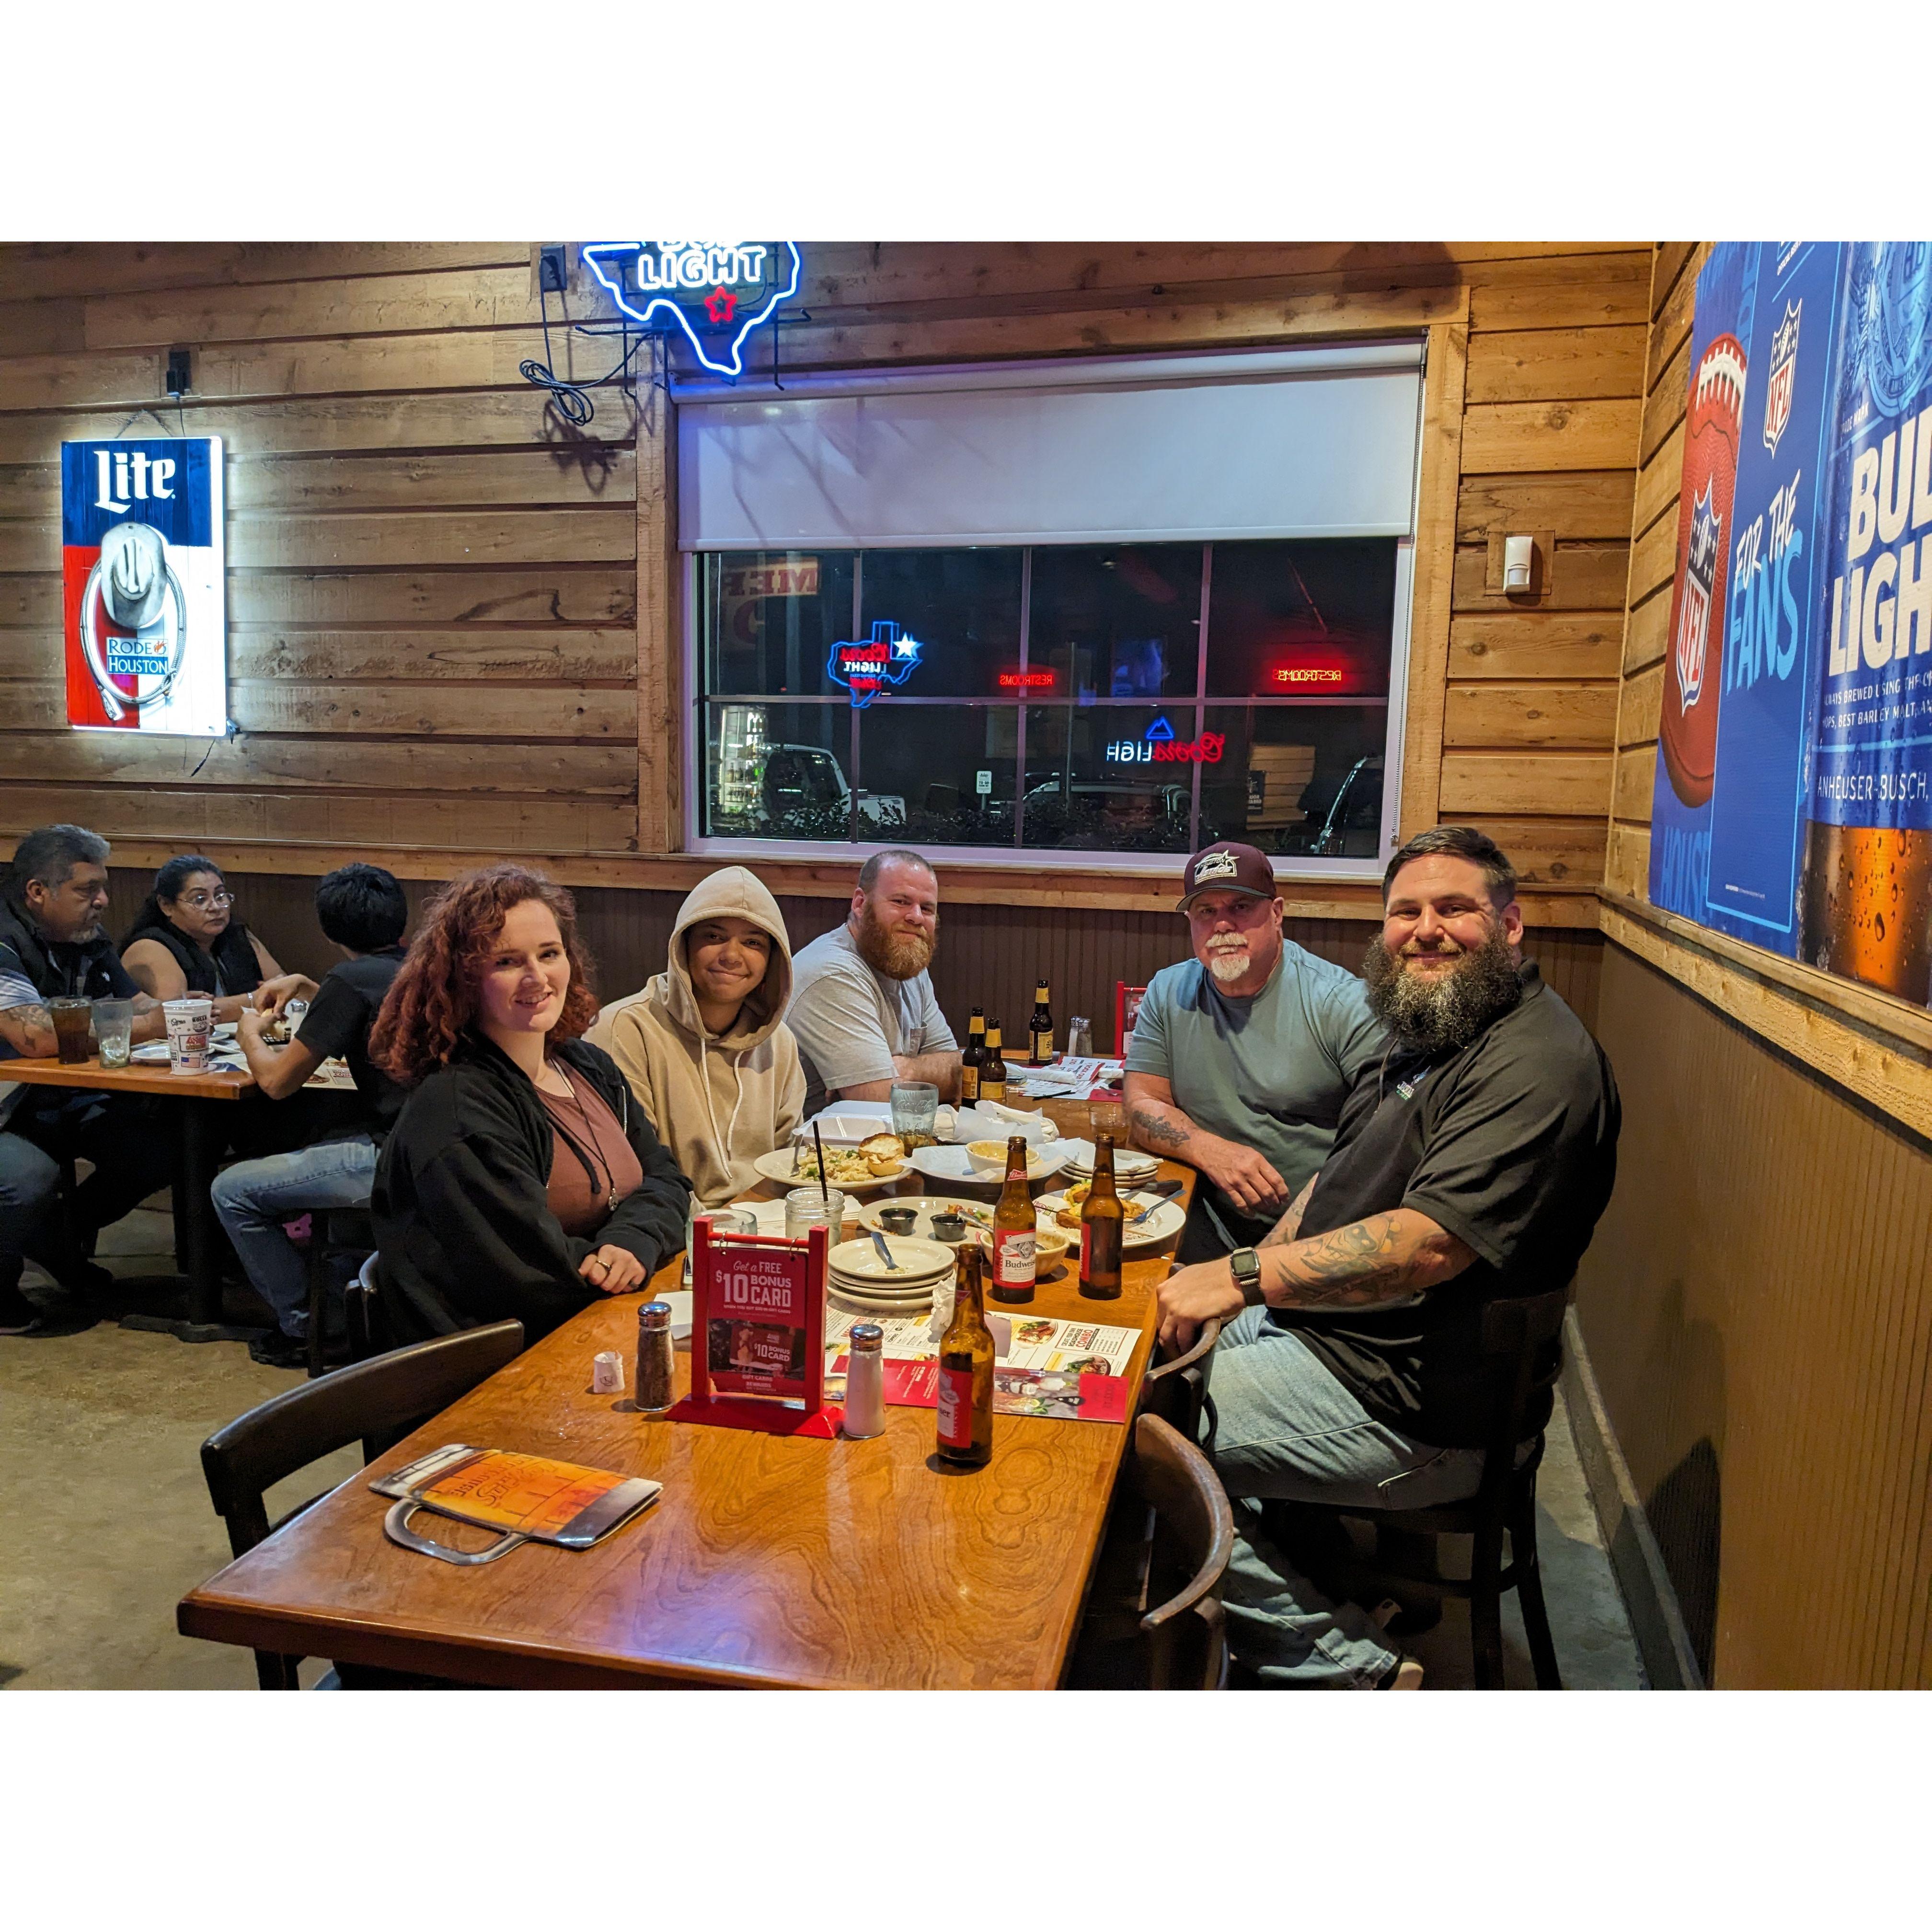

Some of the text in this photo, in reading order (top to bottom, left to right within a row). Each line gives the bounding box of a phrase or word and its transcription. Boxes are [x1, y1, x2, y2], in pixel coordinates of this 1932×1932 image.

[638, 245, 767, 289] LIGHT
[1767, 362, 1790, 434] NFL
[93, 450, 176, 514] Lite
[1735, 469, 1801, 598] FOR THE
[1726, 528, 1803, 695] FANS
[1679, 578, 1705, 685] NFL
[108, 656, 169, 673] HOUSTON
[1843, 686, 1873, 704] BREWED
[1875, 678, 1901, 697] USING
[1838, 713, 1855, 728] BEST
[1858, 706, 1890, 725] BARLEY
[1892, 702, 1917, 720] MALT,
[1817, 771, 1929, 802] ANHEUSER-BUSCH,
[733, 1260, 749, 1271] Get
[759, 1261, 782, 1274] FREE
[716, 1270, 792, 1303] $10 BONUS
[751, 1286, 791, 1307] CARD
[754, 1343, 790, 1358] $10 BONUS
[1068, 1328, 1083, 1347] ROADHOUSE
[1075, 1329, 1093, 1348] COMBO
[768, 1352, 790, 1362] CARD
